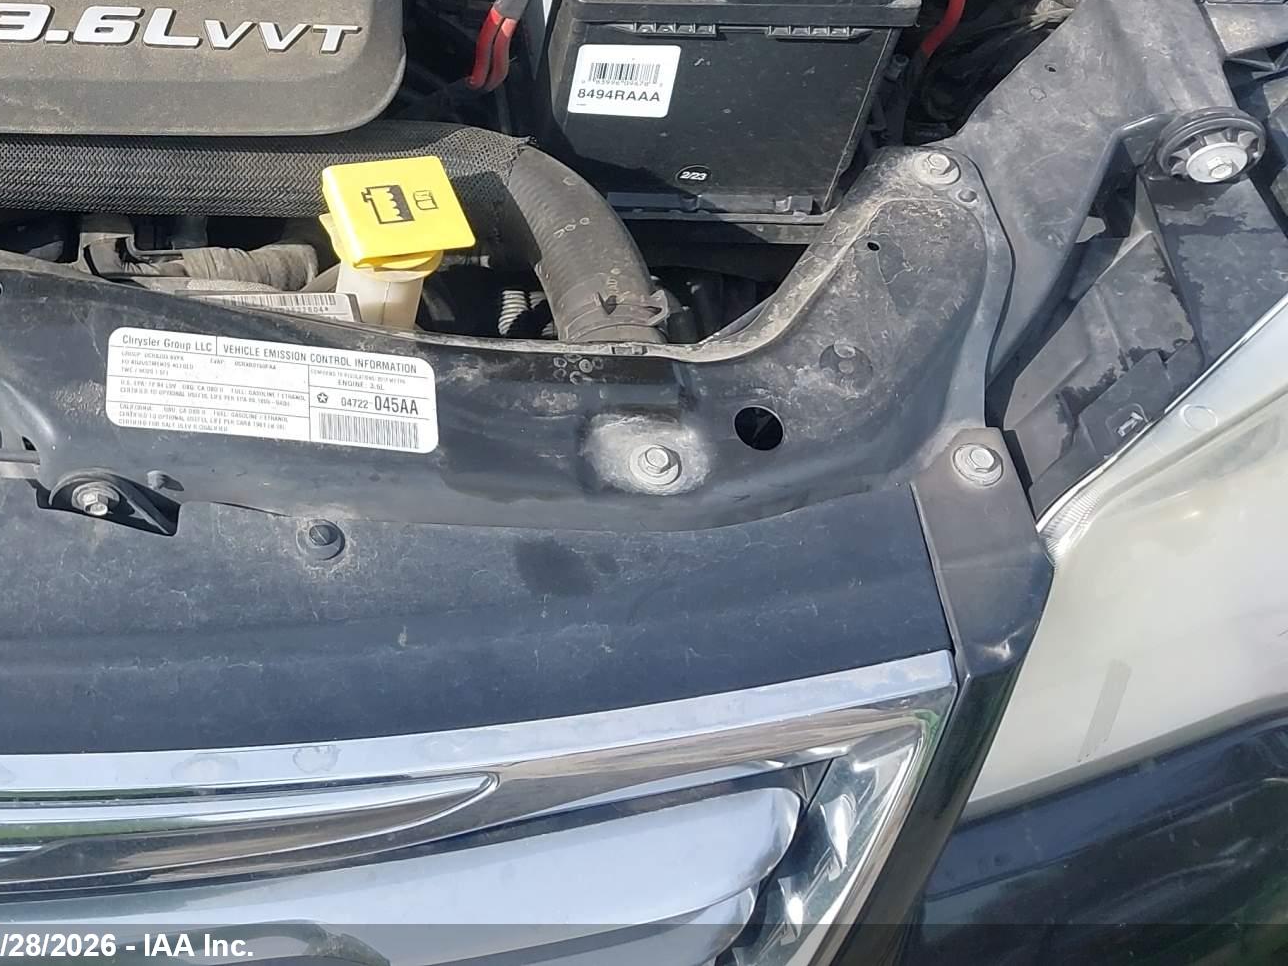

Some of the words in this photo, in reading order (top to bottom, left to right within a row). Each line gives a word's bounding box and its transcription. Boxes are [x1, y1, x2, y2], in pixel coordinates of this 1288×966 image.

[205, 18, 362, 55] VVT
[577, 88, 660, 102] 8494RAAA
[679, 171, 707, 181] 2/23
[123, 334, 160, 347] Chrysler
[164, 338, 191, 351] Group
[195, 341, 212, 352] LLC
[223, 343, 260, 356] VEHICLE
[264, 348, 306, 361] EMISSION
[310, 353, 352, 367] CONTROL
[355, 358, 417, 374] INFORMATION
